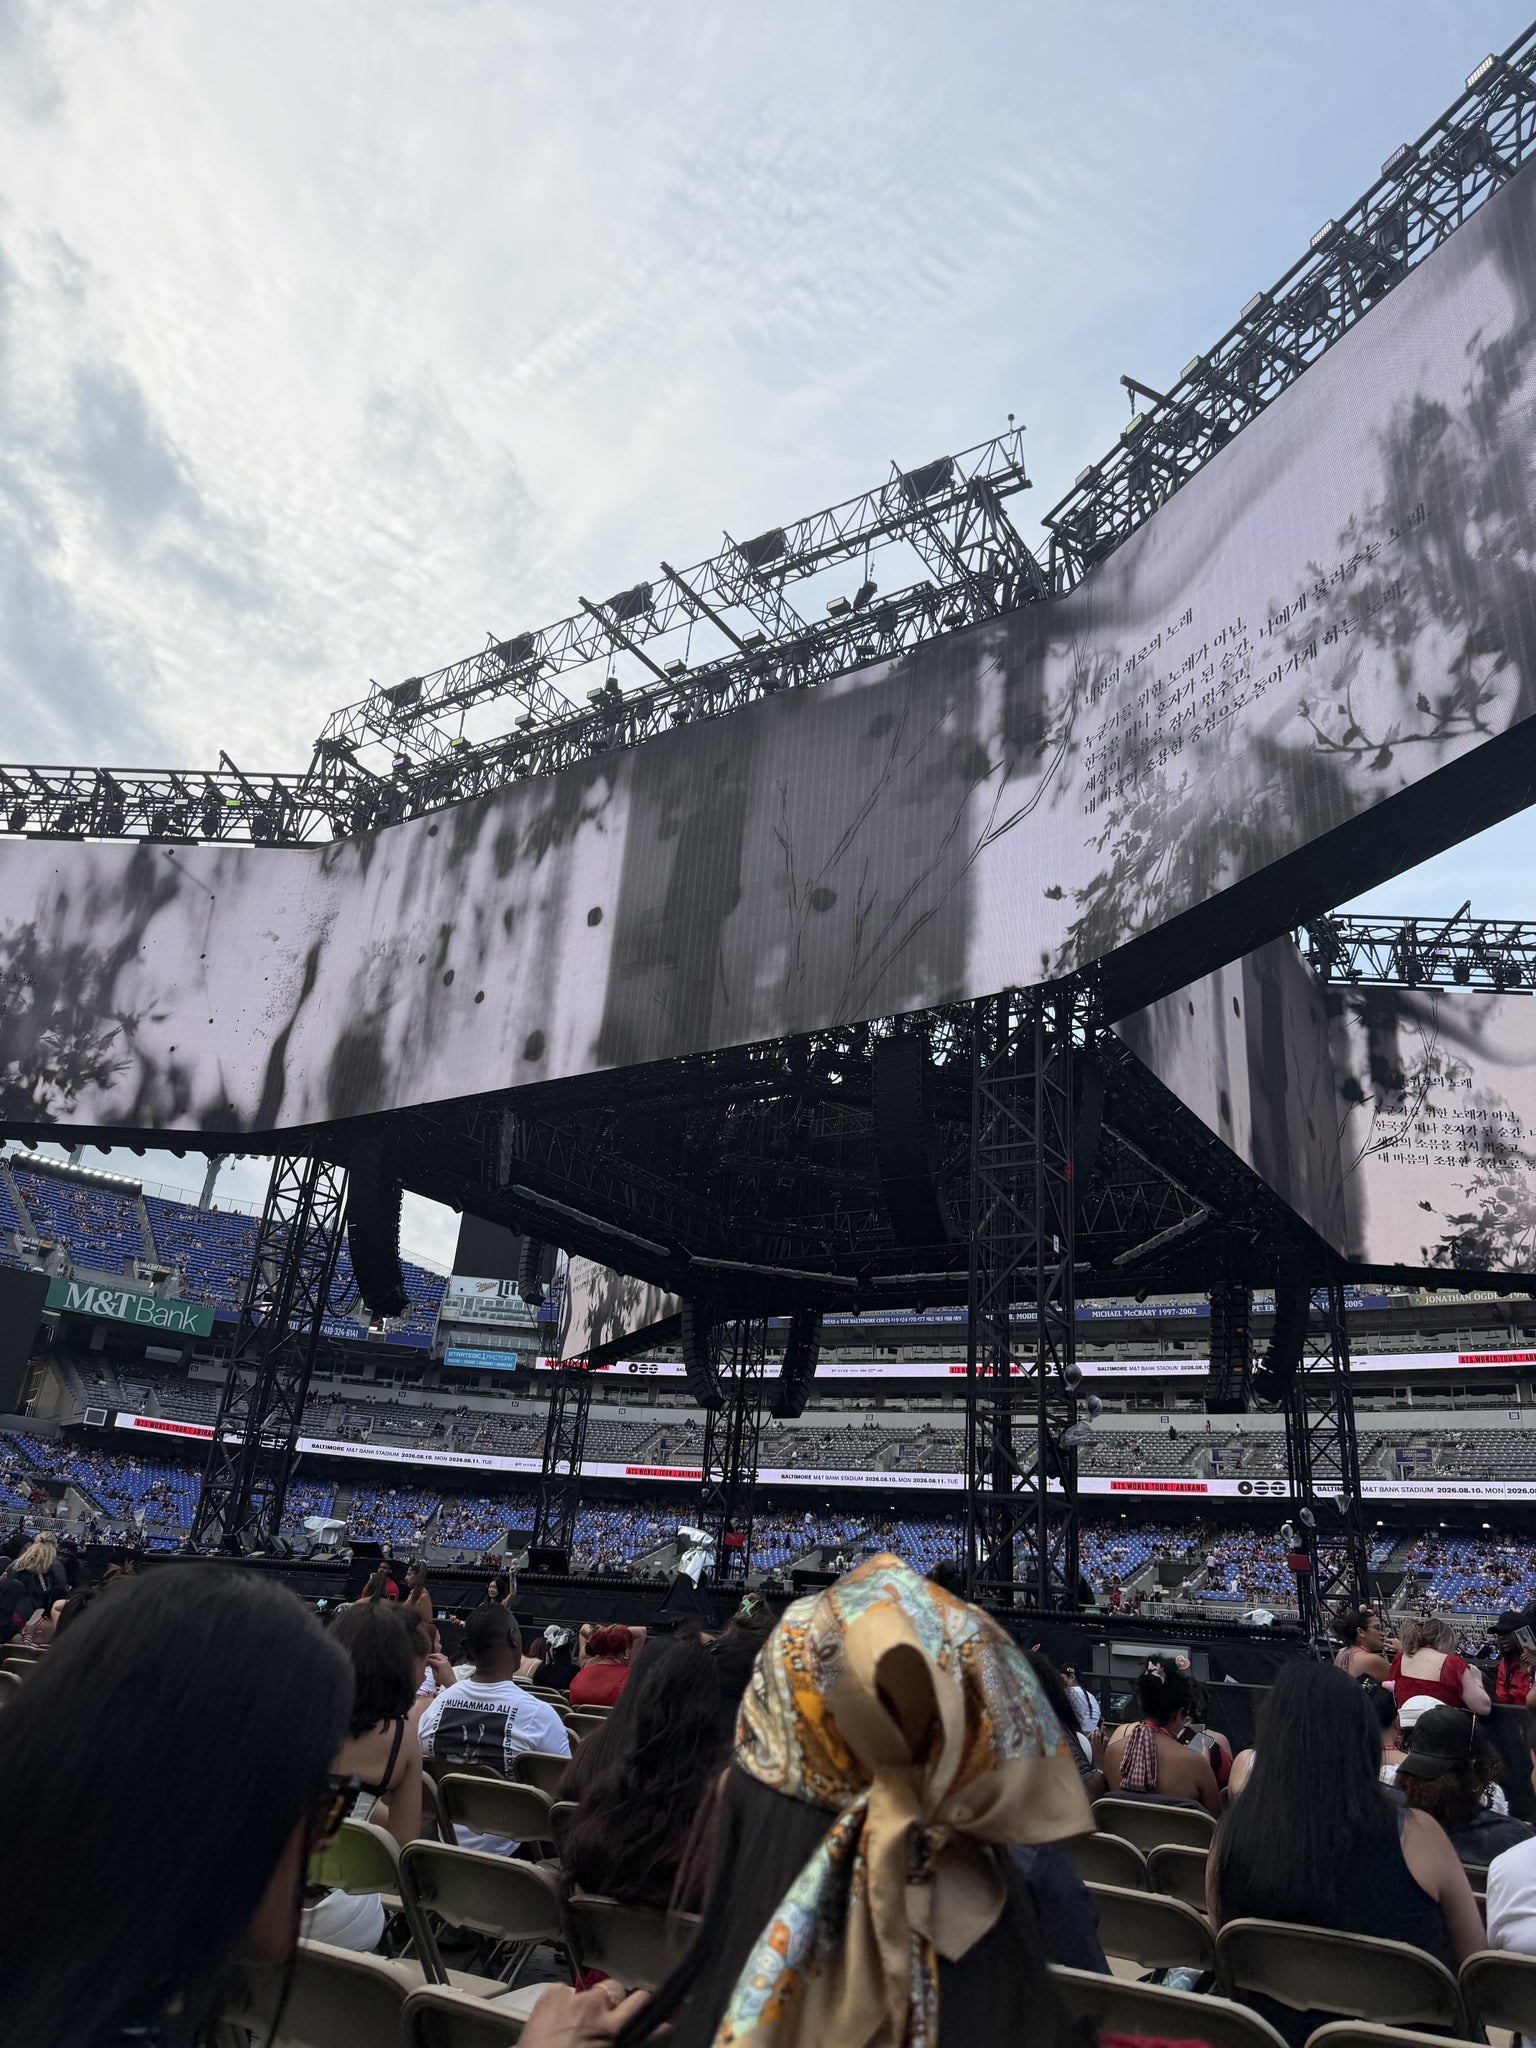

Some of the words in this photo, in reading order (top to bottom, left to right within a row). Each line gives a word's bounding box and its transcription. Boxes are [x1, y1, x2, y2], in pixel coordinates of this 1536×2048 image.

[1085, 668, 1120, 704] 내면의
[1124, 633, 1161, 674] 위로의
[1166, 608, 1193, 642] 노래
[1085, 736, 1121, 771] 한국을
[1155, 679, 1196, 719] 혼자가
[1201, 663, 1215, 685] 된
[1219, 638, 1254, 671] 순간,
[1259, 593, 1307, 638] 나에게
[1312, 541, 1382, 601] 불러주는
[1084, 703, 1133, 748] 누군가를
[1138, 680, 1163, 708] 위한
[1167, 644, 1209, 688] 노래가
[1213, 617, 1247, 648] 아닌,
[1085, 797, 1095, 814] 내
[1100, 768, 1138, 802] 마음의
[1143, 736, 1184, 778] 조용한
[1188, 694, 1247, 744] 중심으로
[1252, 640, 1318, 700] 돌아가게
[1322, 616, 1359, 646] 하는
[1084, 757, 1121, 792] 세상의
[1124, 727, 1165, 766] 소음을
[1169, 701, 1196, 732] 잠시
[1202, 668, 1250, 709] 멈추고,
[1449, 1078, 1472, 1089] 노래
[1425, 1107, 1448, 1119] 위한
[1452, 1109, 1488, 1121] 노래가
[1492, 1110, 1520, 1123] 아닌,
[1442, 1123, 1478, 1136] 혼자가
[1482, 1125, 1494, 1137] 된
[1498, 1126, 1526, 1139] 순간,
[1456, 1140, 1479, 1152] 잠시
[1378, 1152, 1389, 1163] 내
[1393, 1153, 1429, 1165] 마음의
[1433, 1155, 1469, 1167] 조용한
[497, 1279, 520, 1298] Lit
[1425, 1294, 1472, 1305] JONATHAN
[1474, 1292, 1505, 1301] OGDE
[62, 1282, 136, 1319] M&T
[135, 1297, 199, 1333] Bank
[1092, 1310, 1122, 1318] MICHAEL
[1124, 1309, 1156, 1317] McCRARY
[1159, 1307, 1197, 1316] 1997-2002
[311, 1443, 345, 1452] BALTIMORE
[375, 1449, 400, 1457] STADIUM
[1112, 1481, 1125, 1490] BTS
[1126, 1482, 1149, 1491] WORLD
[1151, 1483, 1168, 1491] TOUR
[1175, 1484, 1206, 1492] ARIRANG
[446, 1699, 495, 1712] MUHAMMAD
[496, 1704, 511, 1714] ALI
[509, 1706, 518, 1721] THE
